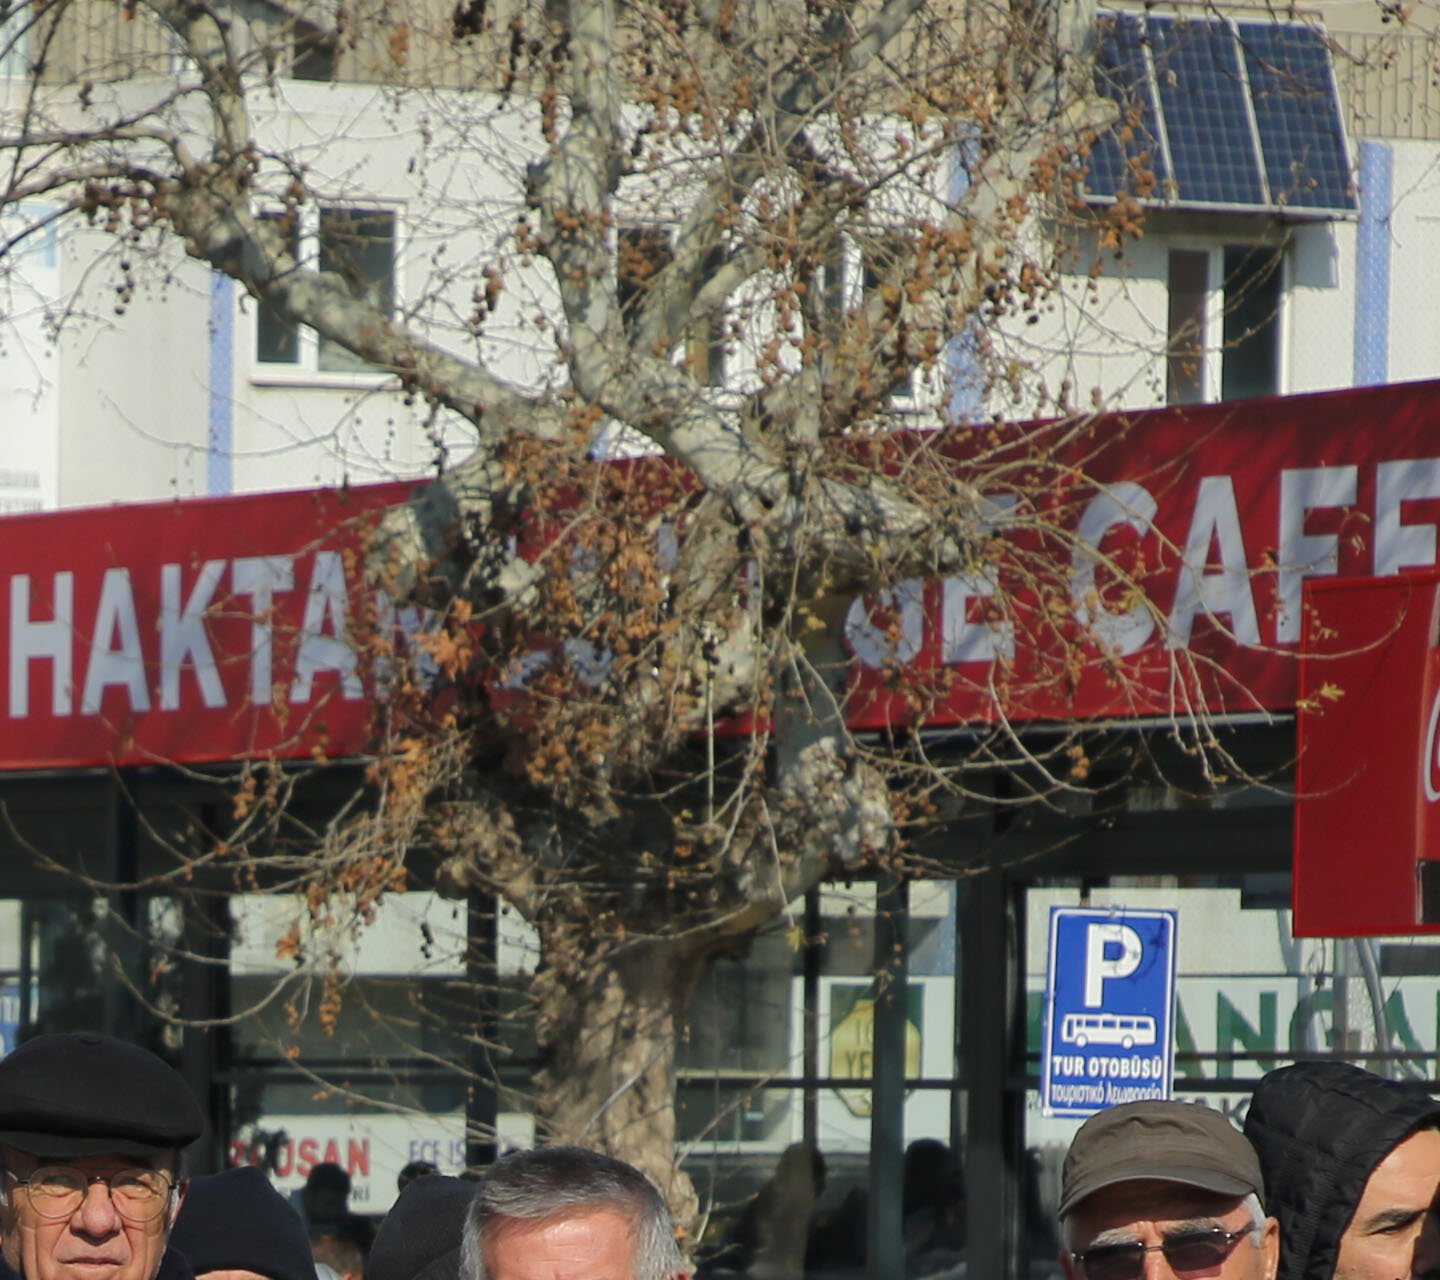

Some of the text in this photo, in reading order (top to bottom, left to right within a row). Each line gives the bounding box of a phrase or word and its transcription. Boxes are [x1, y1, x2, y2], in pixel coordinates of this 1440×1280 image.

[8, 550, 438, 720] HAKTA
[1084, 923, 1142, 1007] P
[1052, 1054, 1163, 1079] TUR OTOBÜSÜ
